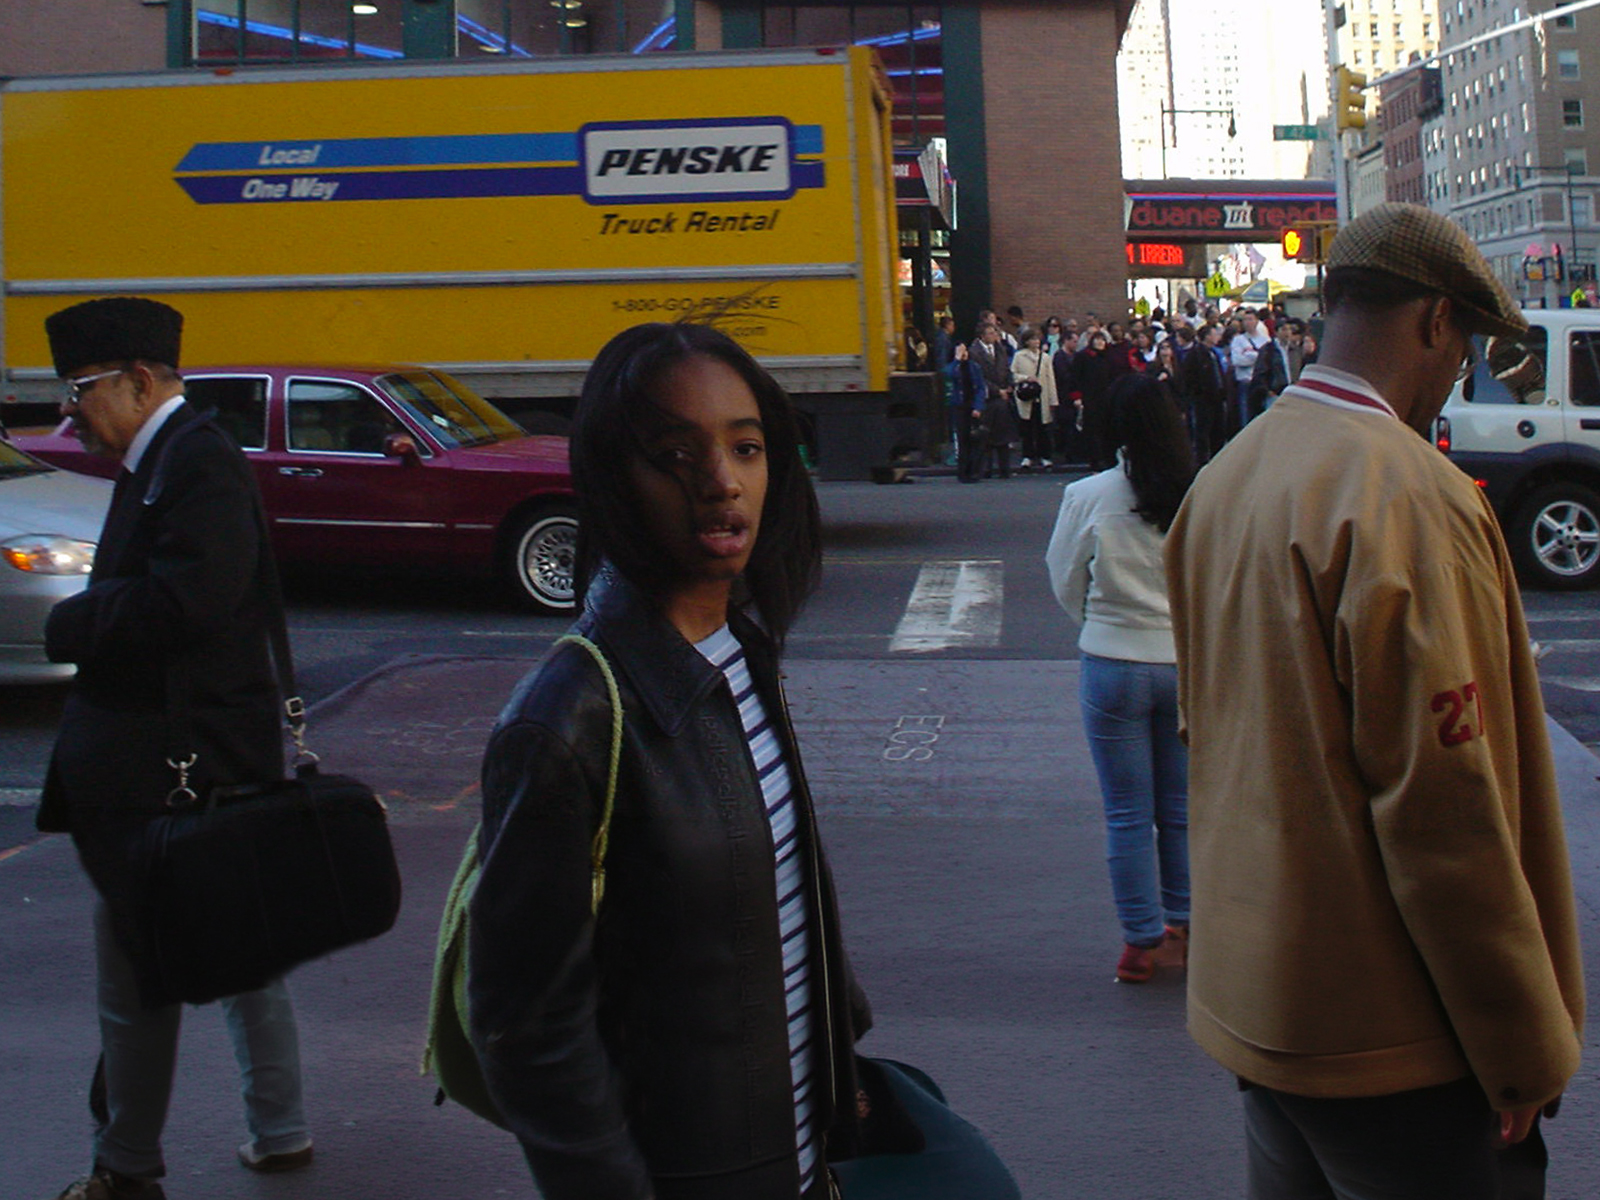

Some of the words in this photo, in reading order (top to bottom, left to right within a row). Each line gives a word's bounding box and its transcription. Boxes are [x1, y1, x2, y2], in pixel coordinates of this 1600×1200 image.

[259, 145, 322, 165] Local
[596, 143, 779, 177] PENSKE
[241, 178, 288, 199] One
[289, 177, 340, 201] Way
[599, 211, 678, 235] Truck
[684, 209, 780, 234] Rental
[1133, 201, 1222, 227] duane
